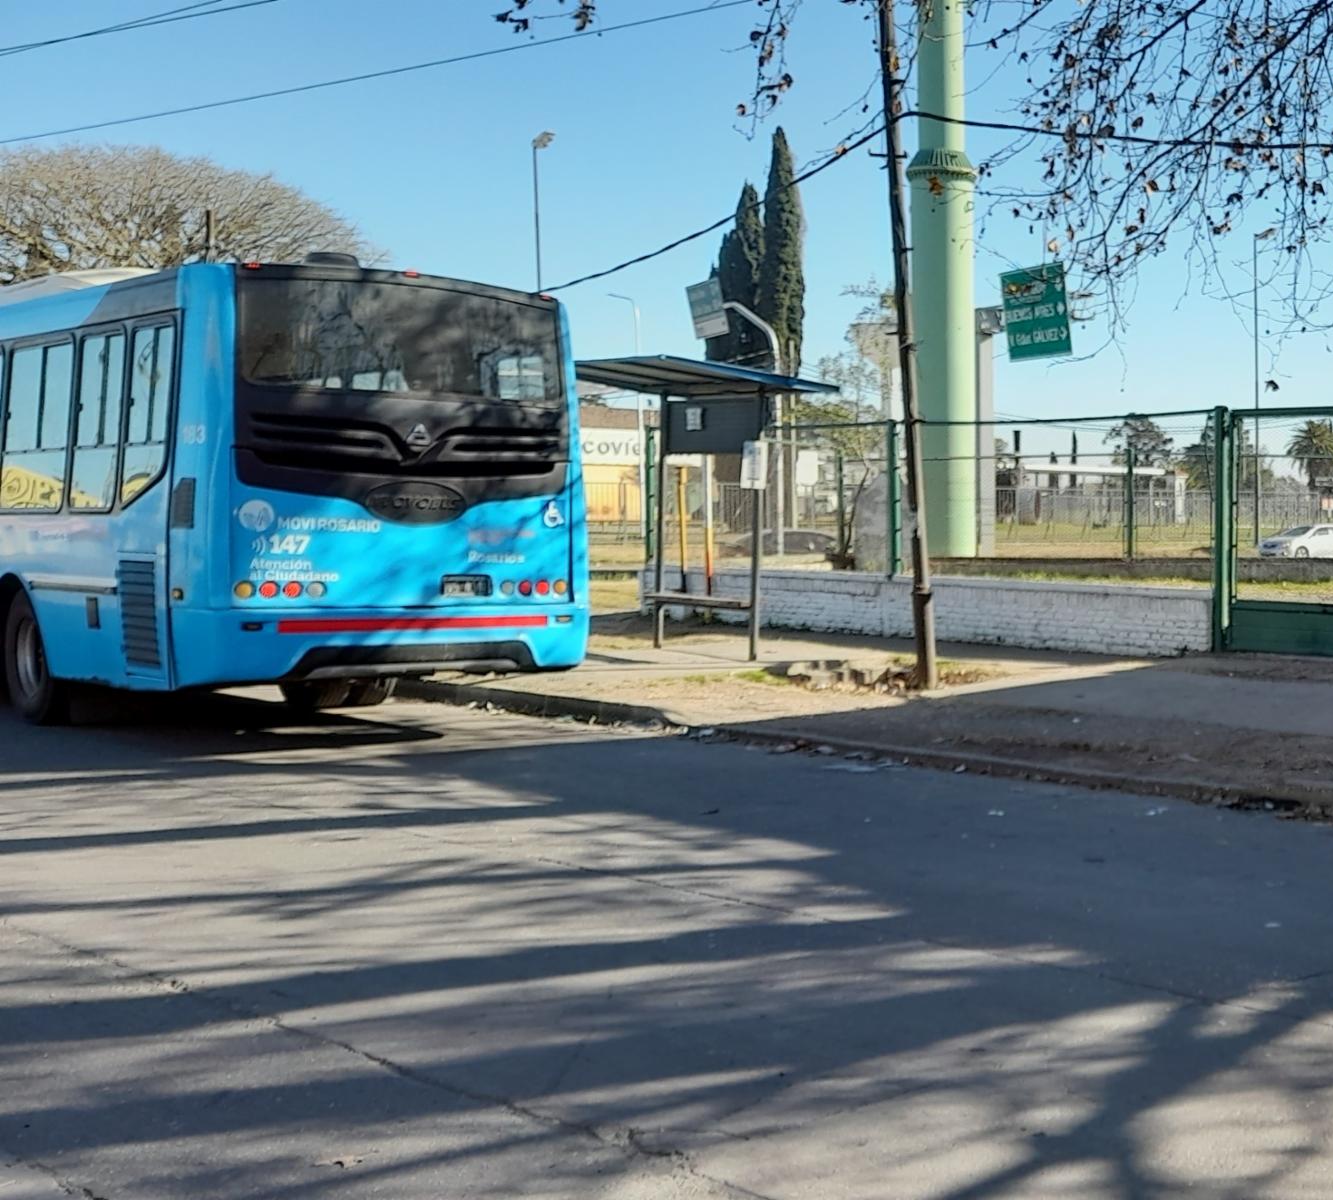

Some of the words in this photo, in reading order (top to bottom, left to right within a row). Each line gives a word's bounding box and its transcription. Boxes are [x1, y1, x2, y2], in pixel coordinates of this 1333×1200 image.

[317, 518, 381, 533] ROSARIO
[269, 533, 311, 555] 147
[250, 557, 312, 571] Atención
[264, 570, 340, 582] Ciudadano
